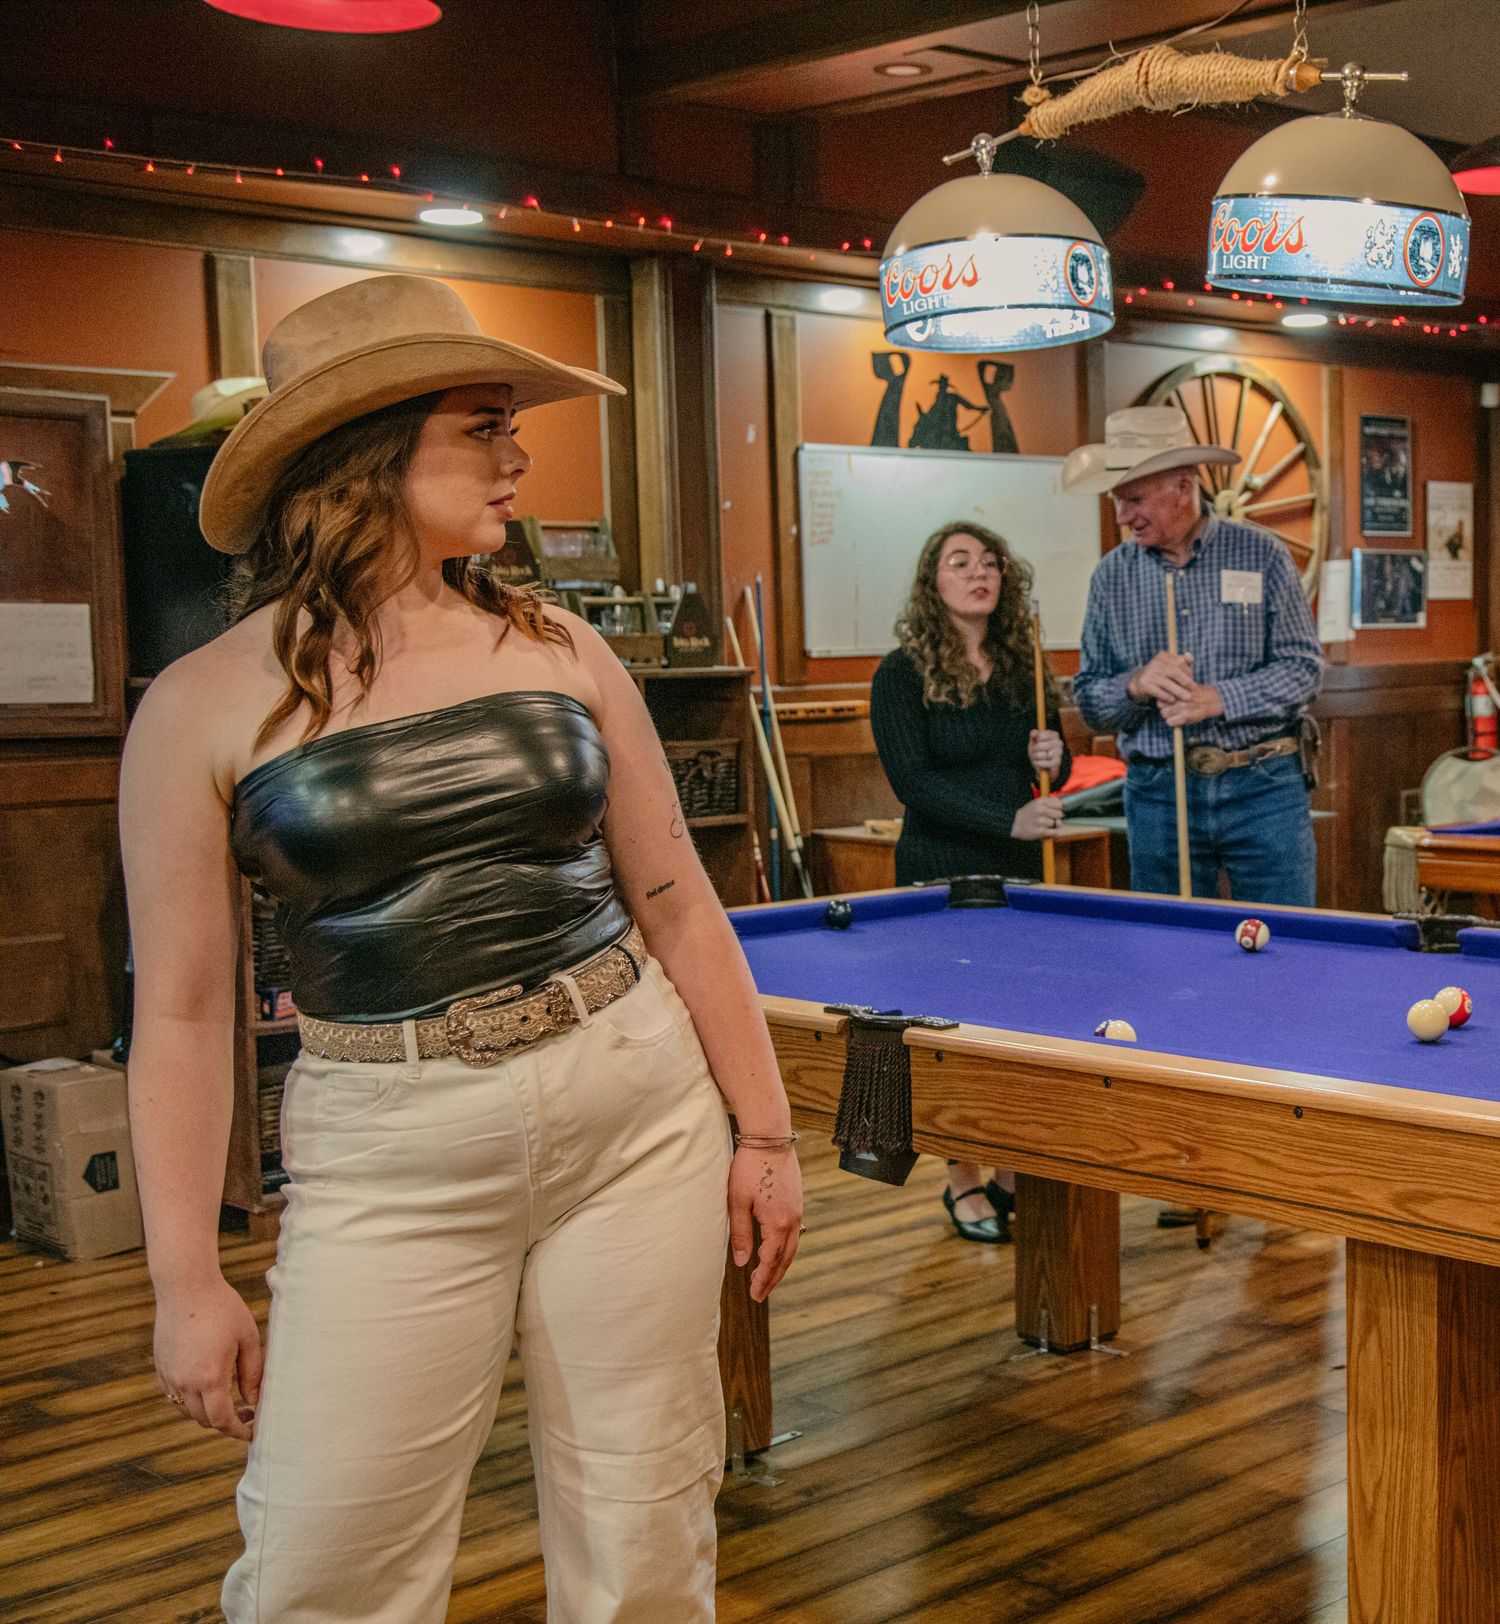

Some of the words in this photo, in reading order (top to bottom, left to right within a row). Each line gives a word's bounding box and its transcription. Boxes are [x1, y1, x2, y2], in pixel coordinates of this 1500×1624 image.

[1209, 203, 1309, 255] Coors
[1222, 255, 1271, 269] LIGHT
[885, 254, 979, 307] Coors
[903, 294, 951, 315] LIGHT
